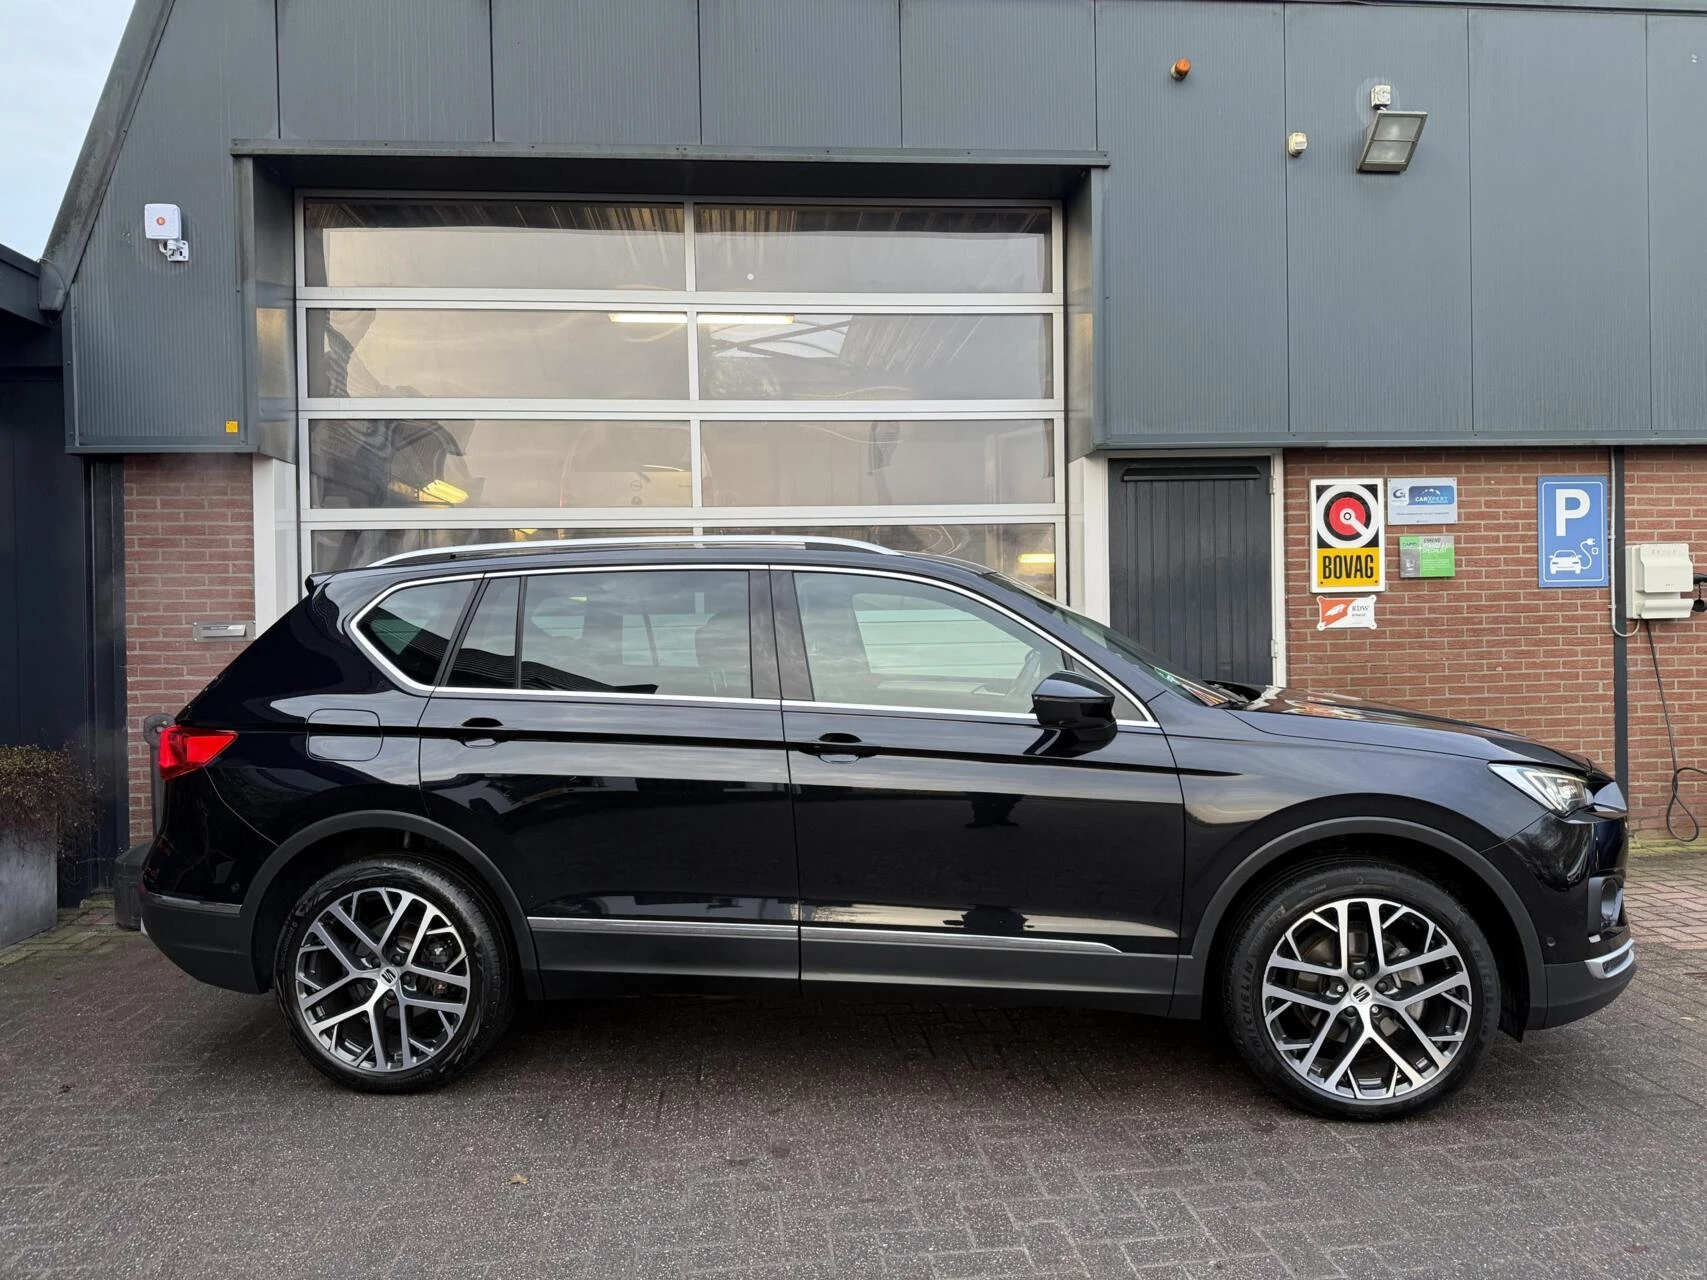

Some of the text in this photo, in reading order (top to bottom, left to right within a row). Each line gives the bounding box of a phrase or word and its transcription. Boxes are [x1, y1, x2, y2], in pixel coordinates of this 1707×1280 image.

[1555, 488, 1591, 537] P
[1322, 554, 1374, 580] BOVAG
[1240, 960, 1261, 1048] MICHELIN
